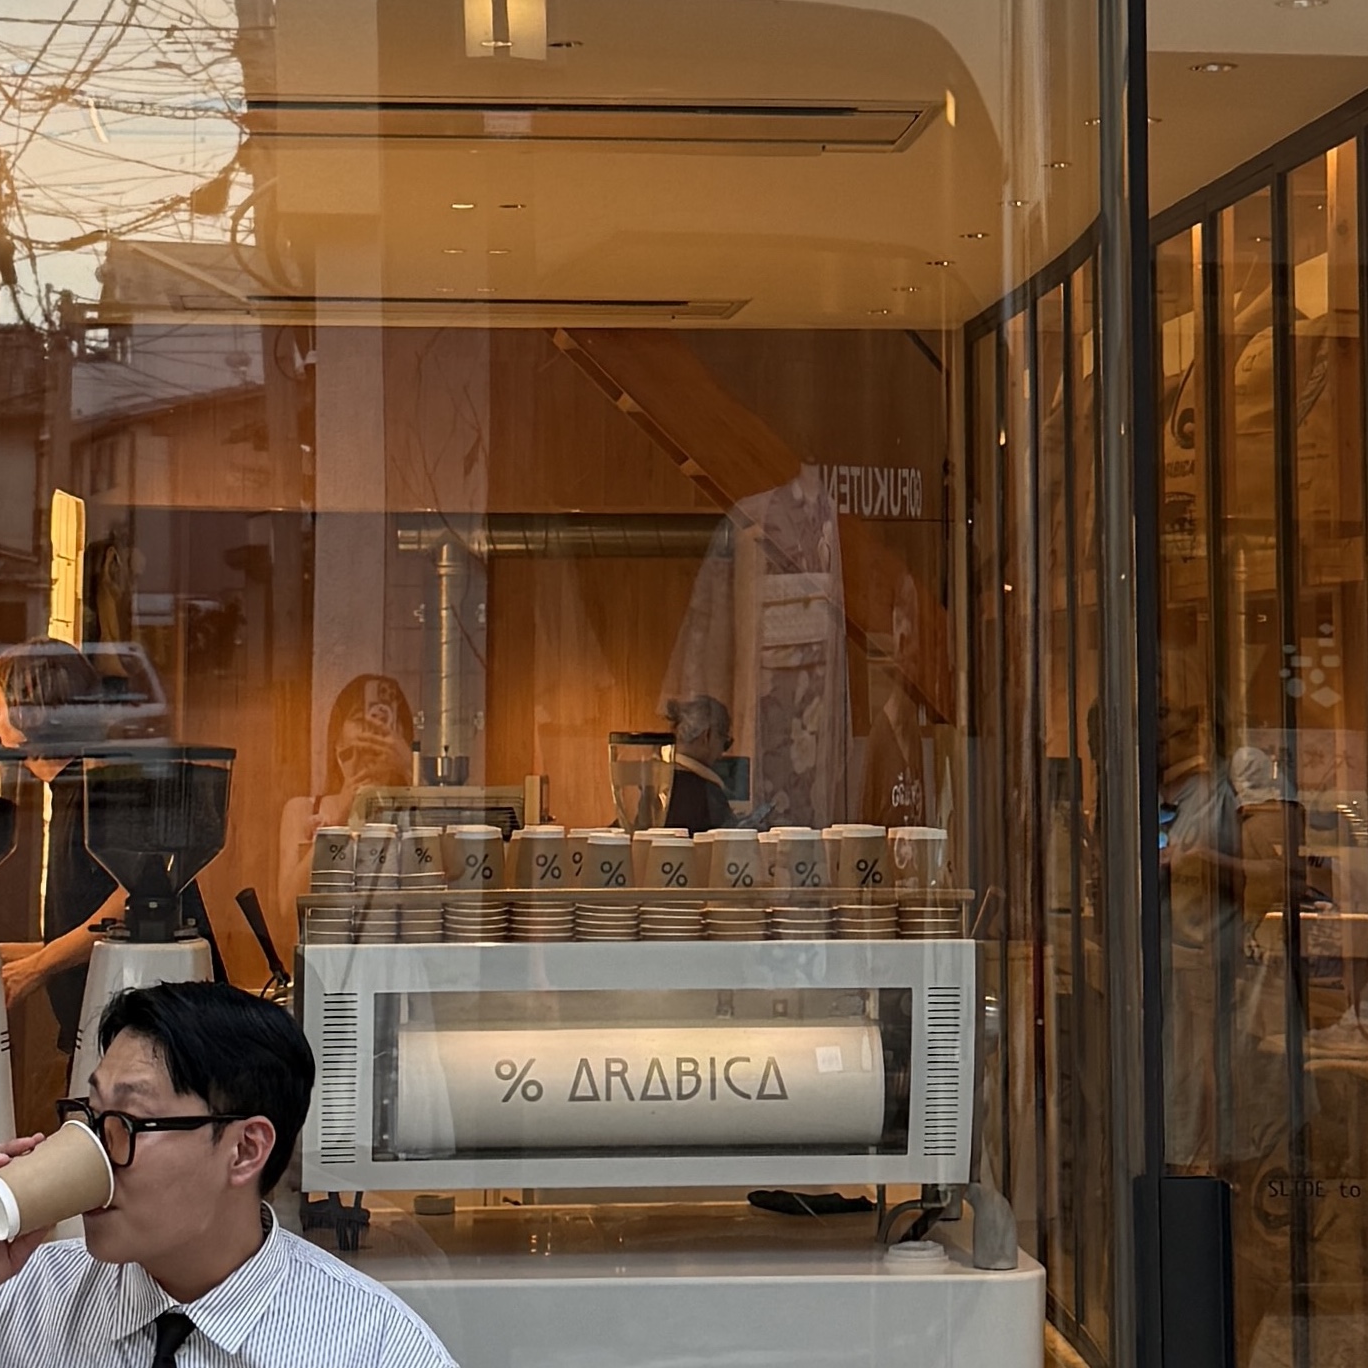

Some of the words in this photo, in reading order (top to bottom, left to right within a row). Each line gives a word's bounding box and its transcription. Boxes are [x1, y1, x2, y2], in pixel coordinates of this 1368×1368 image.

[495, 1058, 543, 1102] %
[568, 1056, 789, 1101] ARABICA
[1268, 1181, 1325, 1198] SLIDE
[1339, 1183, 1361, 1199] to
